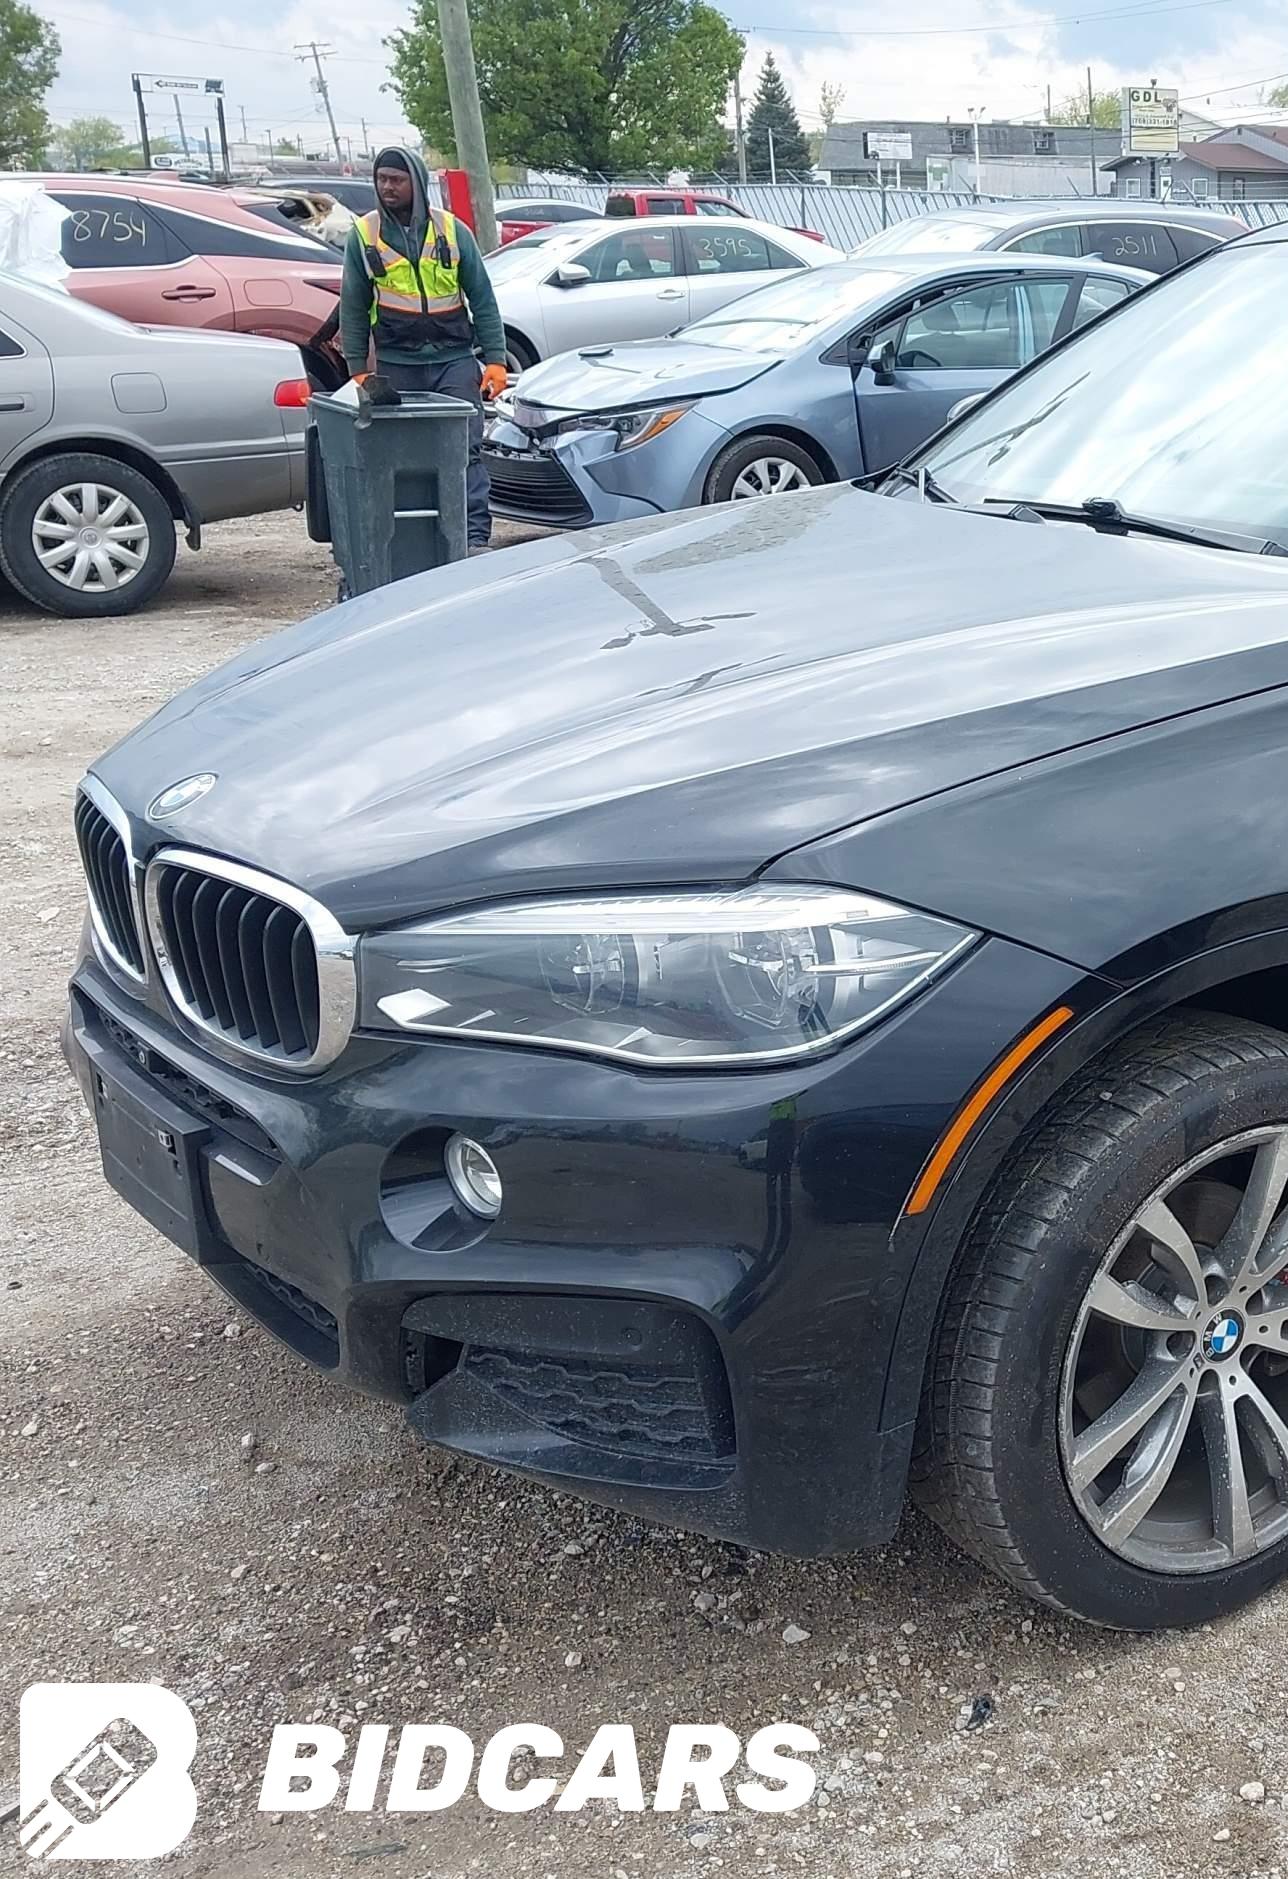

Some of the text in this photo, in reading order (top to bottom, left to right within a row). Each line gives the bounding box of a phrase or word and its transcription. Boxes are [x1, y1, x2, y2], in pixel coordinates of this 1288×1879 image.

[71, 209, 145, 247] 8754
[699, 237, 751, 258] 3595
[1111, 235, 1157, 256] 2511
